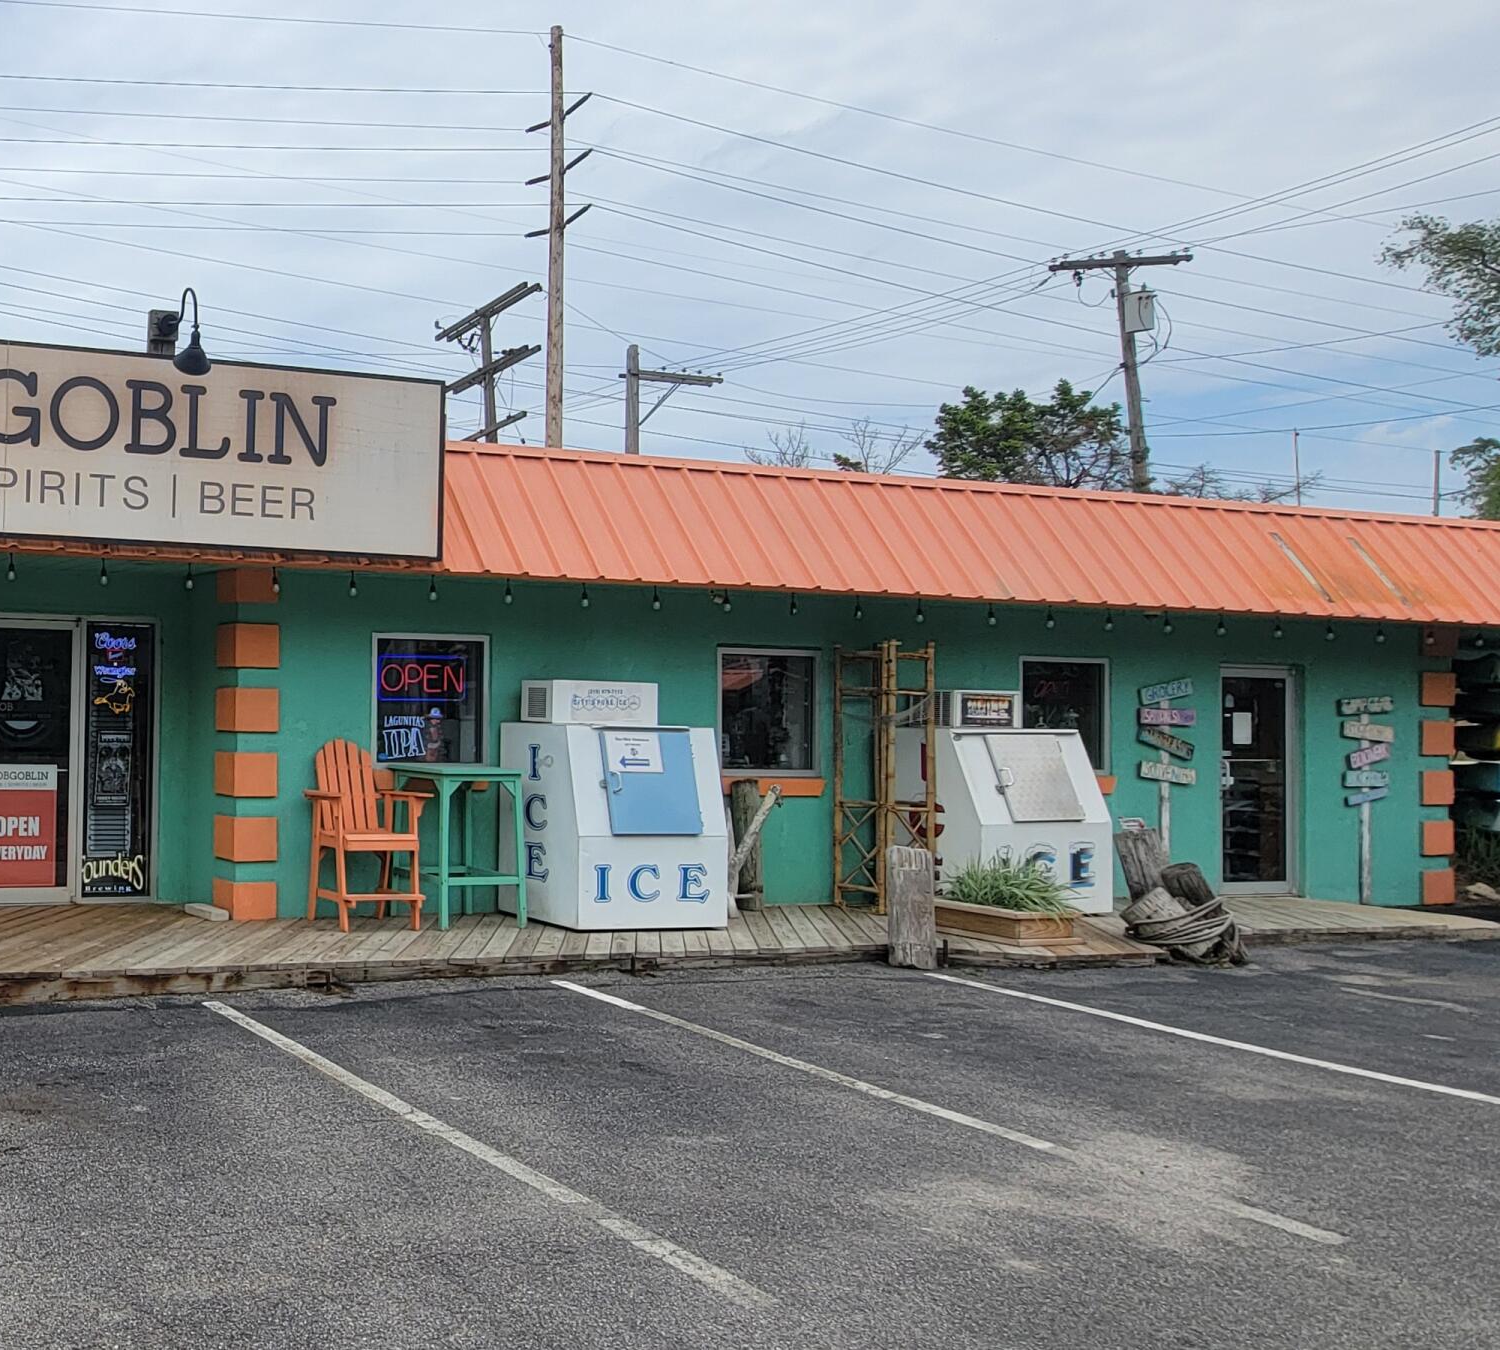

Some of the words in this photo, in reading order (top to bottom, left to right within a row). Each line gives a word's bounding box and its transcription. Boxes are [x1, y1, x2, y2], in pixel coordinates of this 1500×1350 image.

[199, 481, 316, 521] BEER
[381, 663, 463, 693] OPEN
[384, 715, 425, 728] LAGUNITAS
[594, 863, 711, 904] ICE
